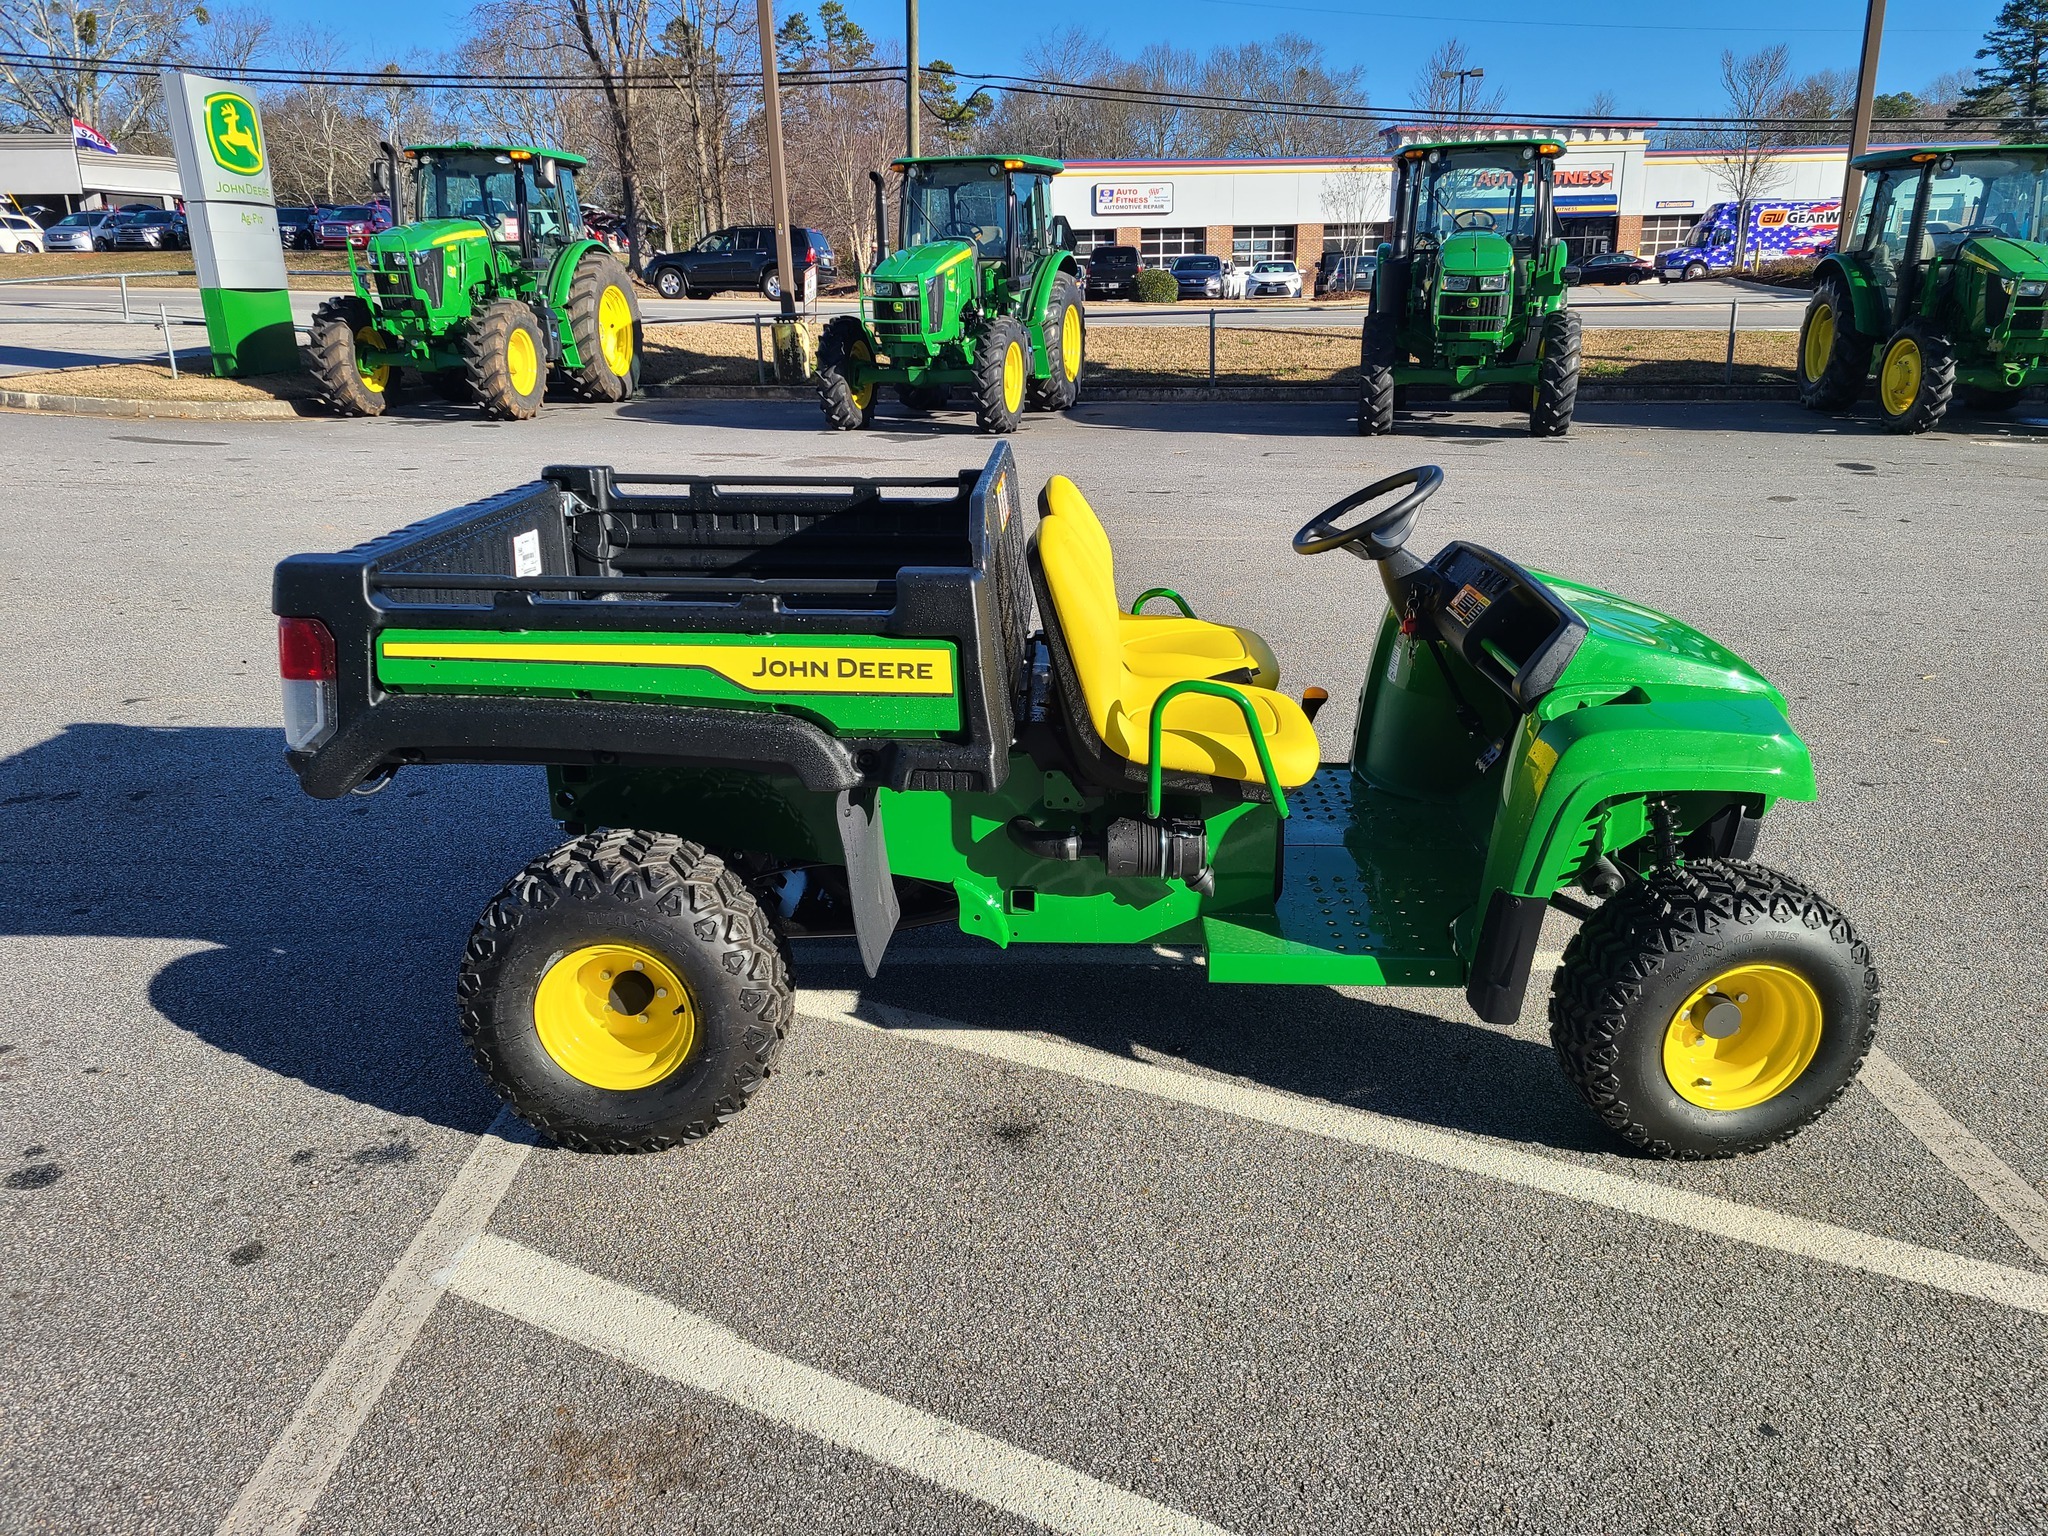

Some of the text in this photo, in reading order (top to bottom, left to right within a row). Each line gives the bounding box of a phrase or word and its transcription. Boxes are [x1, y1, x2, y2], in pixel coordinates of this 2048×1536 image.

[216, 181, 270, 198] JOHN DEERE
[1116, 196, 1149, 204] FITNESS
[752, 656, 933, 680] JOHN DEERE
